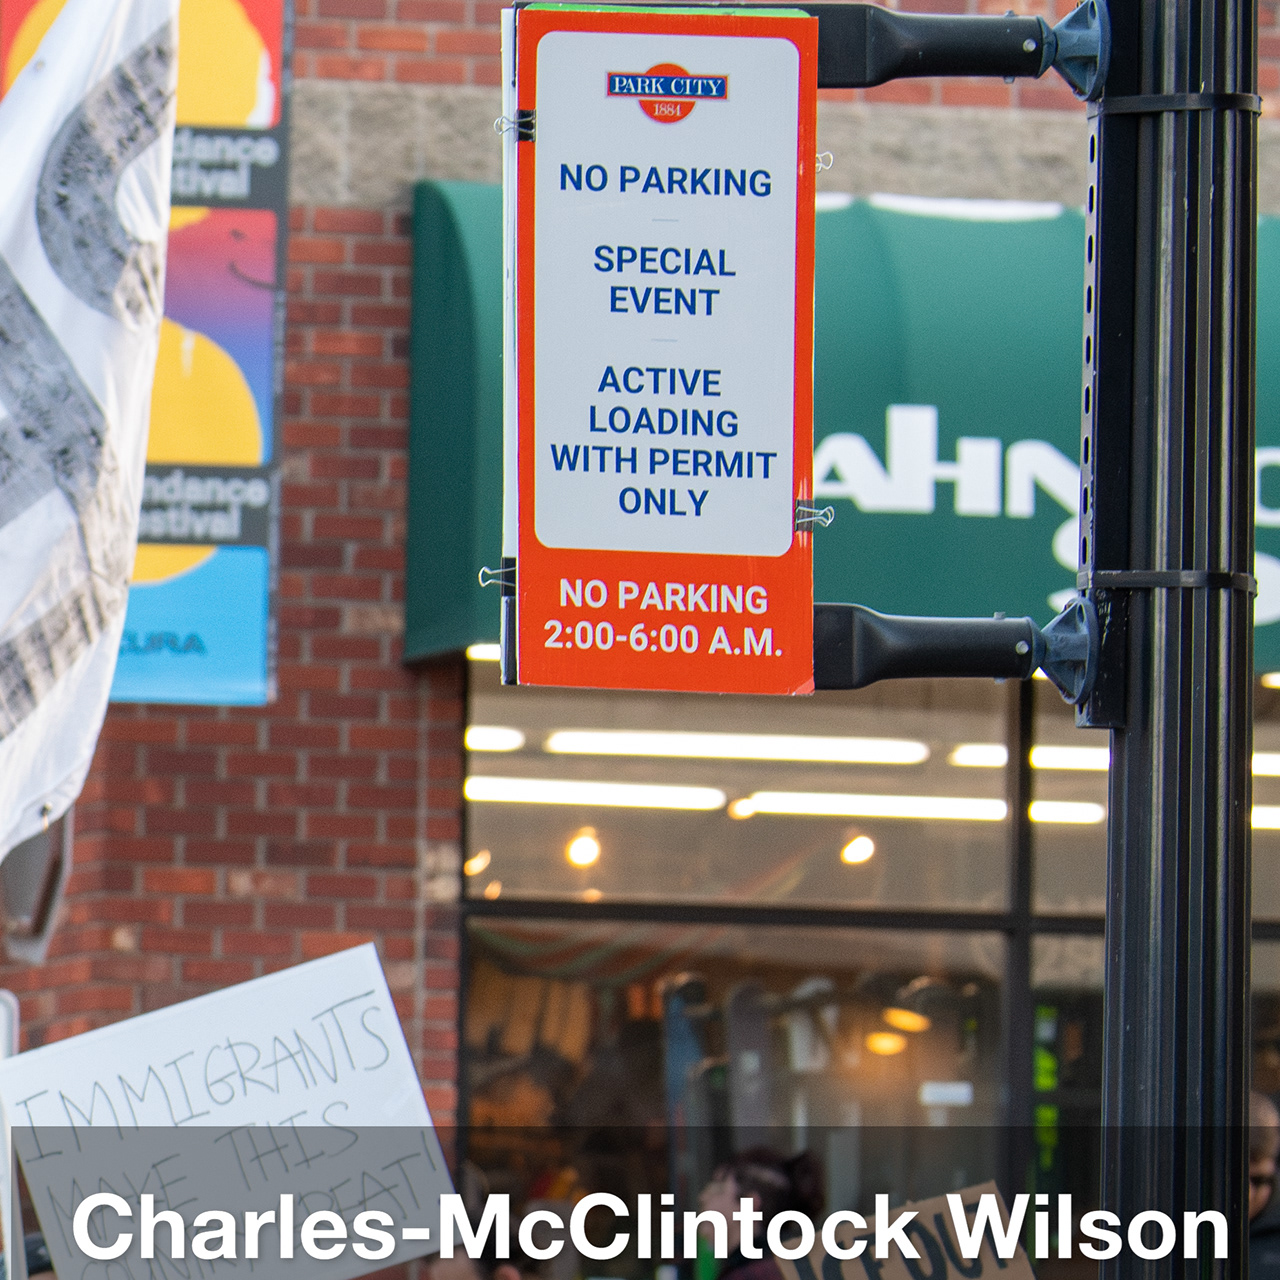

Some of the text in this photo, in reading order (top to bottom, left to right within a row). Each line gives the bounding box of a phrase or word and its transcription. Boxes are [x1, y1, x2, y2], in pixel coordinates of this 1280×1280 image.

[612, 76, 724, 97] PARK CITY
[653, 103, 682, 117] 1884
[173, 130, 280, 166] dance
[171, 164, 251, 197] tival
[559, 163, 772, 197] NO PARKING
[593, 245, 737, 277] SPECIAL
[610, 285, 720, 317] EVENT
[597, 365, 722, 397] ACTIVE
[589, 405, 739, 438] LOADING
[550, 443, 778, 480] WITH PERMIT
[618, 486, 710, 517] ONLY
[558, 578, 769, 615] NO PARKING
[543, 619, 784, 657] 2:00-6:00 A.M.
[14, 989, 390, 1164] IMMIGRANTS
[214, 1100, 359, 1192] THIS
